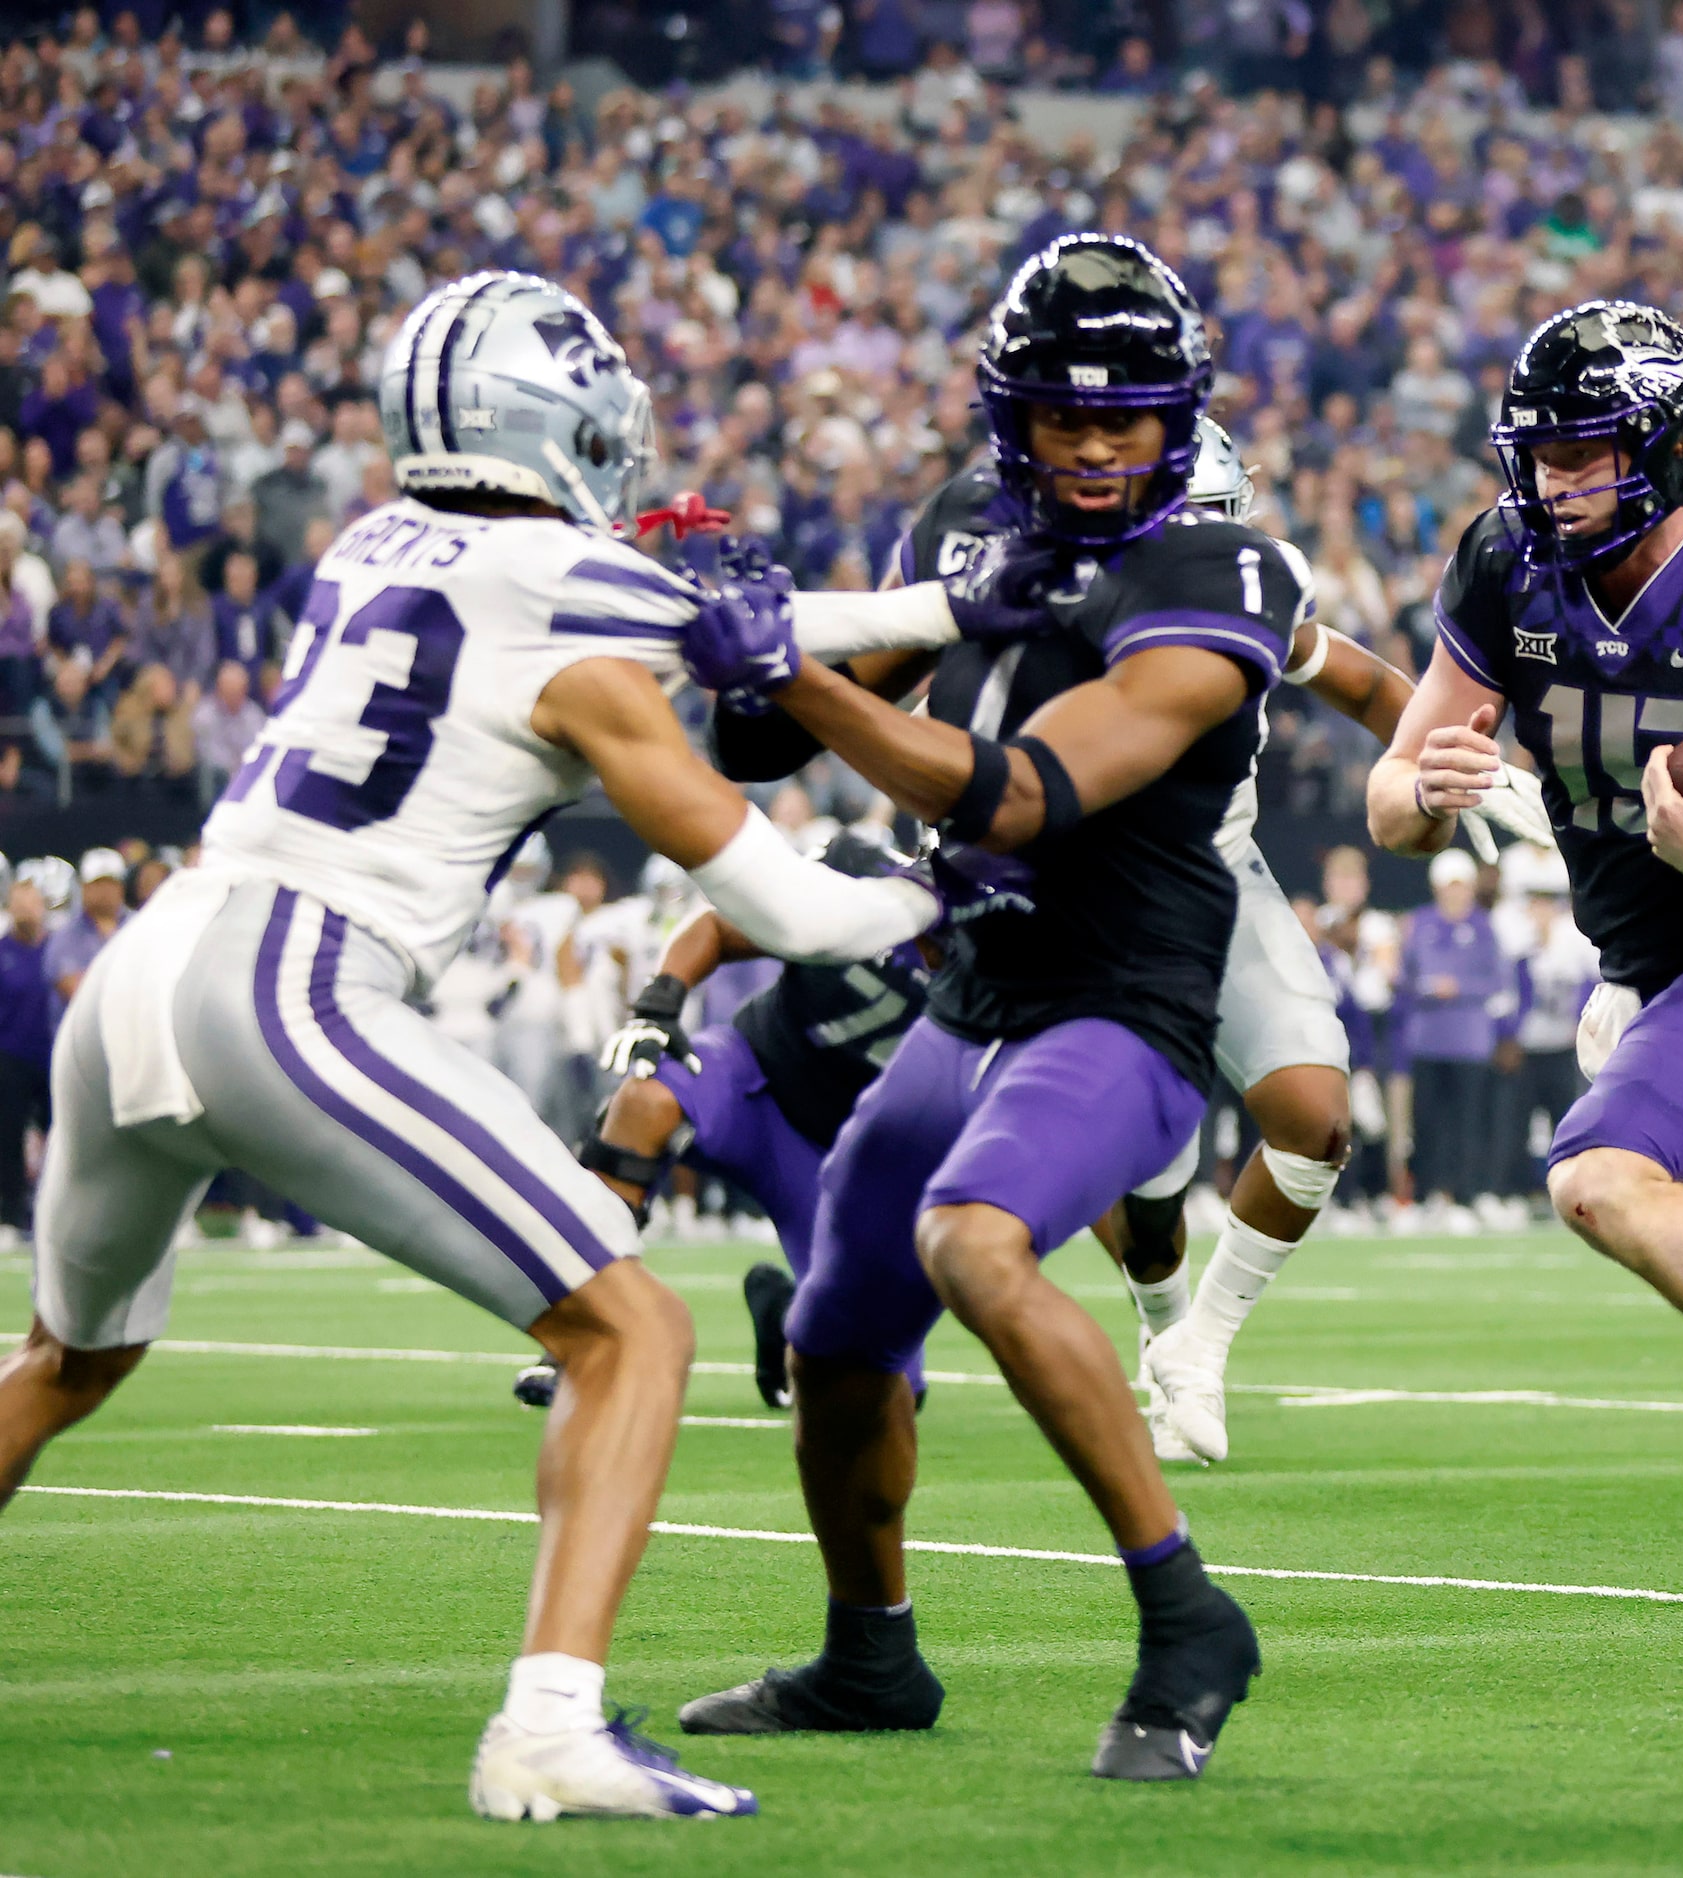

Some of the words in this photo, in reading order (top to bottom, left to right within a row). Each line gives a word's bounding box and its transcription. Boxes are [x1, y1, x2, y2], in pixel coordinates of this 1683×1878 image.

[1067, 365, 1108, 387] TCU
[1511, 406, 1538, 428] TCU
[1596, 640, 1630, 657] TCU
